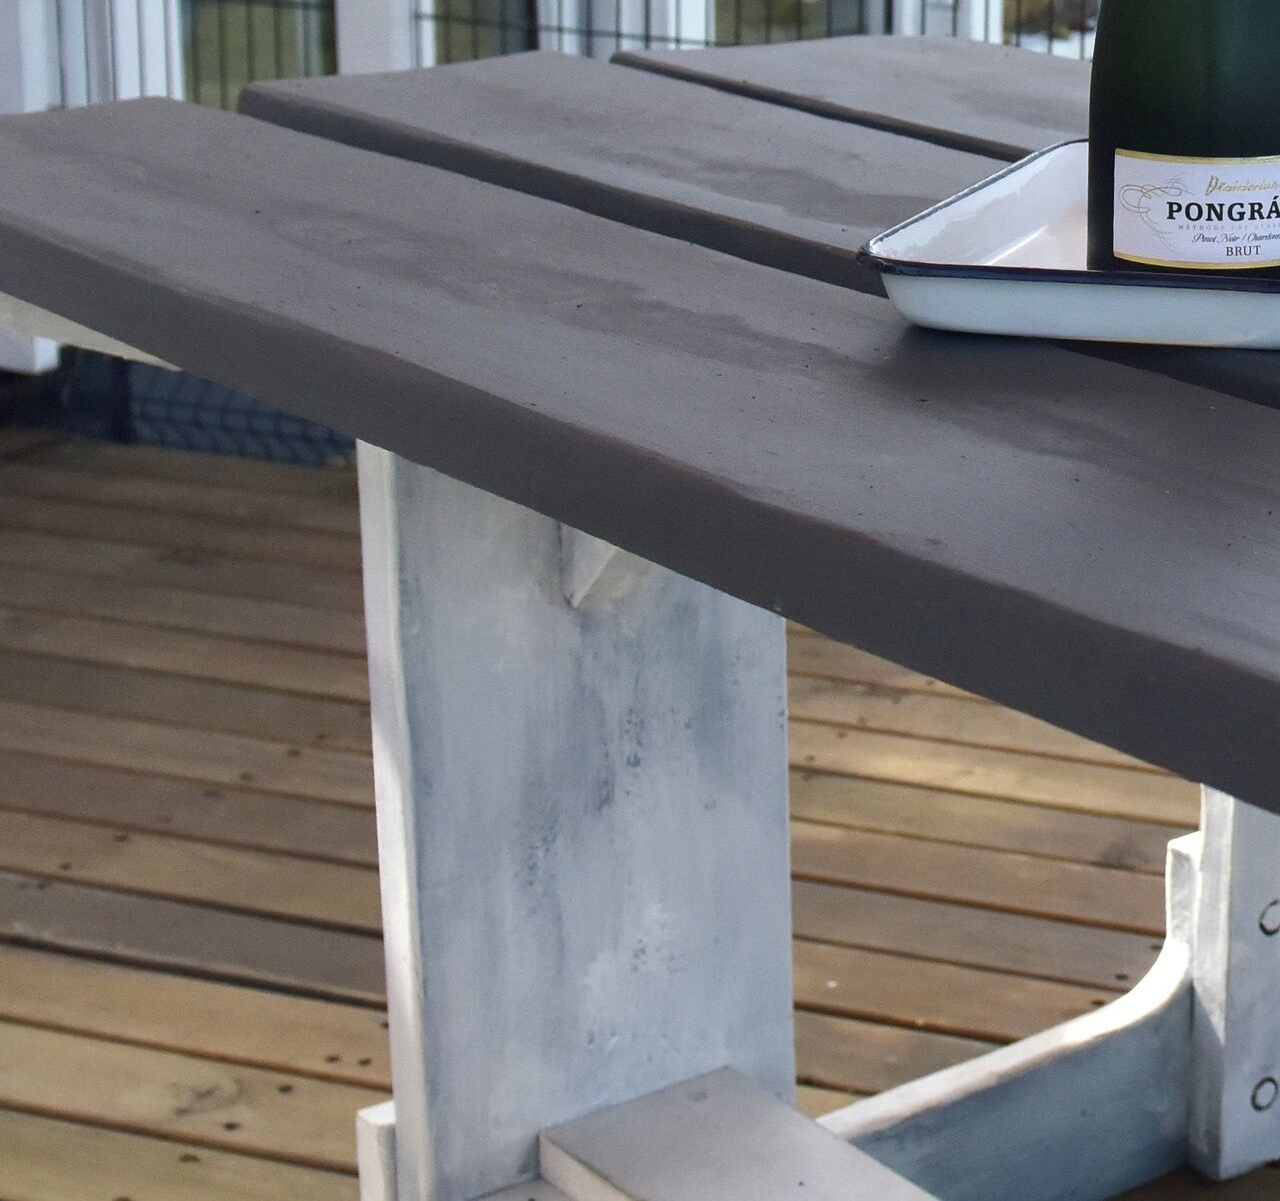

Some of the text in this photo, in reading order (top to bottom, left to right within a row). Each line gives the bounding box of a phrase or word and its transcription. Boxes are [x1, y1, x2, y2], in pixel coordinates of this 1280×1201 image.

[1192, 232, 1216, 243] Pinot
[1217, 233, 1240, 243] Noir
[1226, 245, 1261, 256] BRUT
